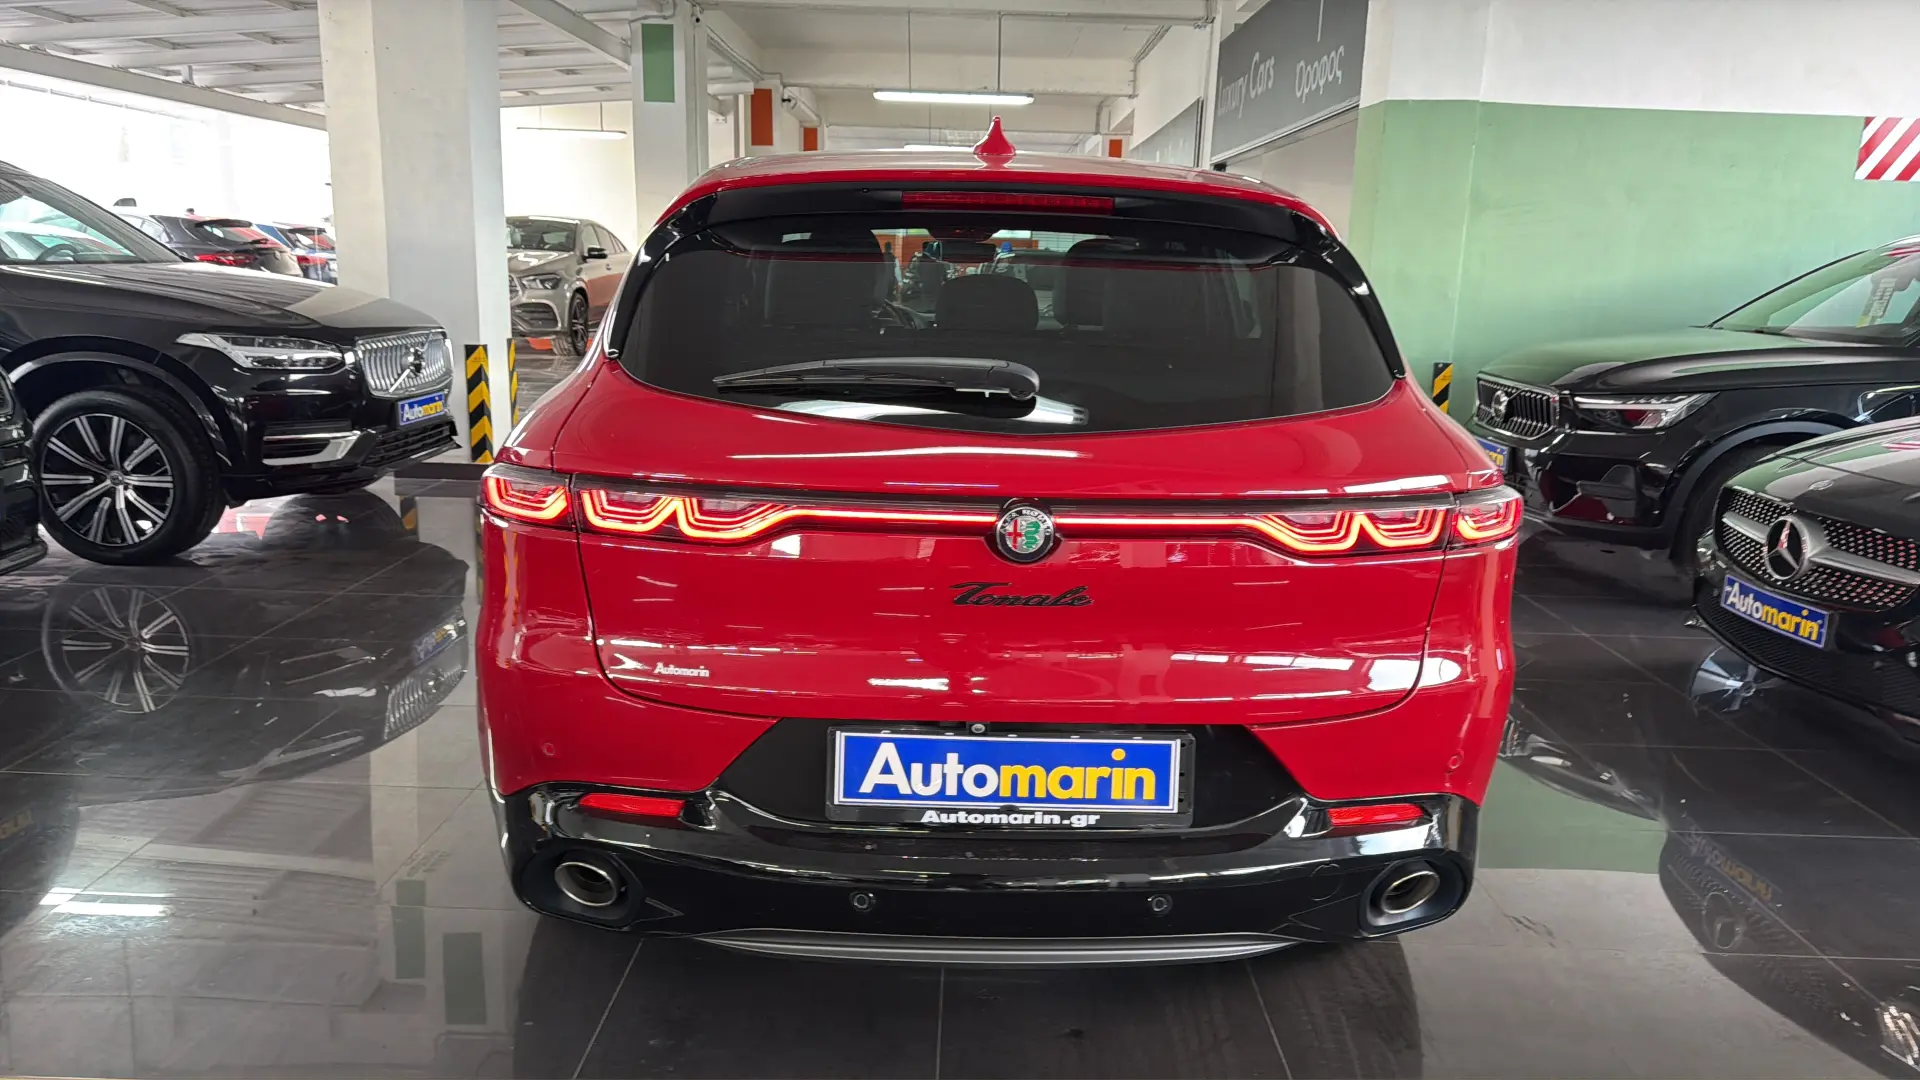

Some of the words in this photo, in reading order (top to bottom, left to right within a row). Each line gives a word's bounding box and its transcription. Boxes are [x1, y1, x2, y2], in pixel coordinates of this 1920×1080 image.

[1217, 73, 1248, 119] Luxury
[1250, 51, 1275, 99] Cars
[949, 581, 1095, 607] Tonale
[1726, 582, 1819, 641] Automarin
[653, 662, 710, 678] Automarin
[858, 742, 1156, 800] Automarin
[920, 810, 1101, 827] Automarin.gr
